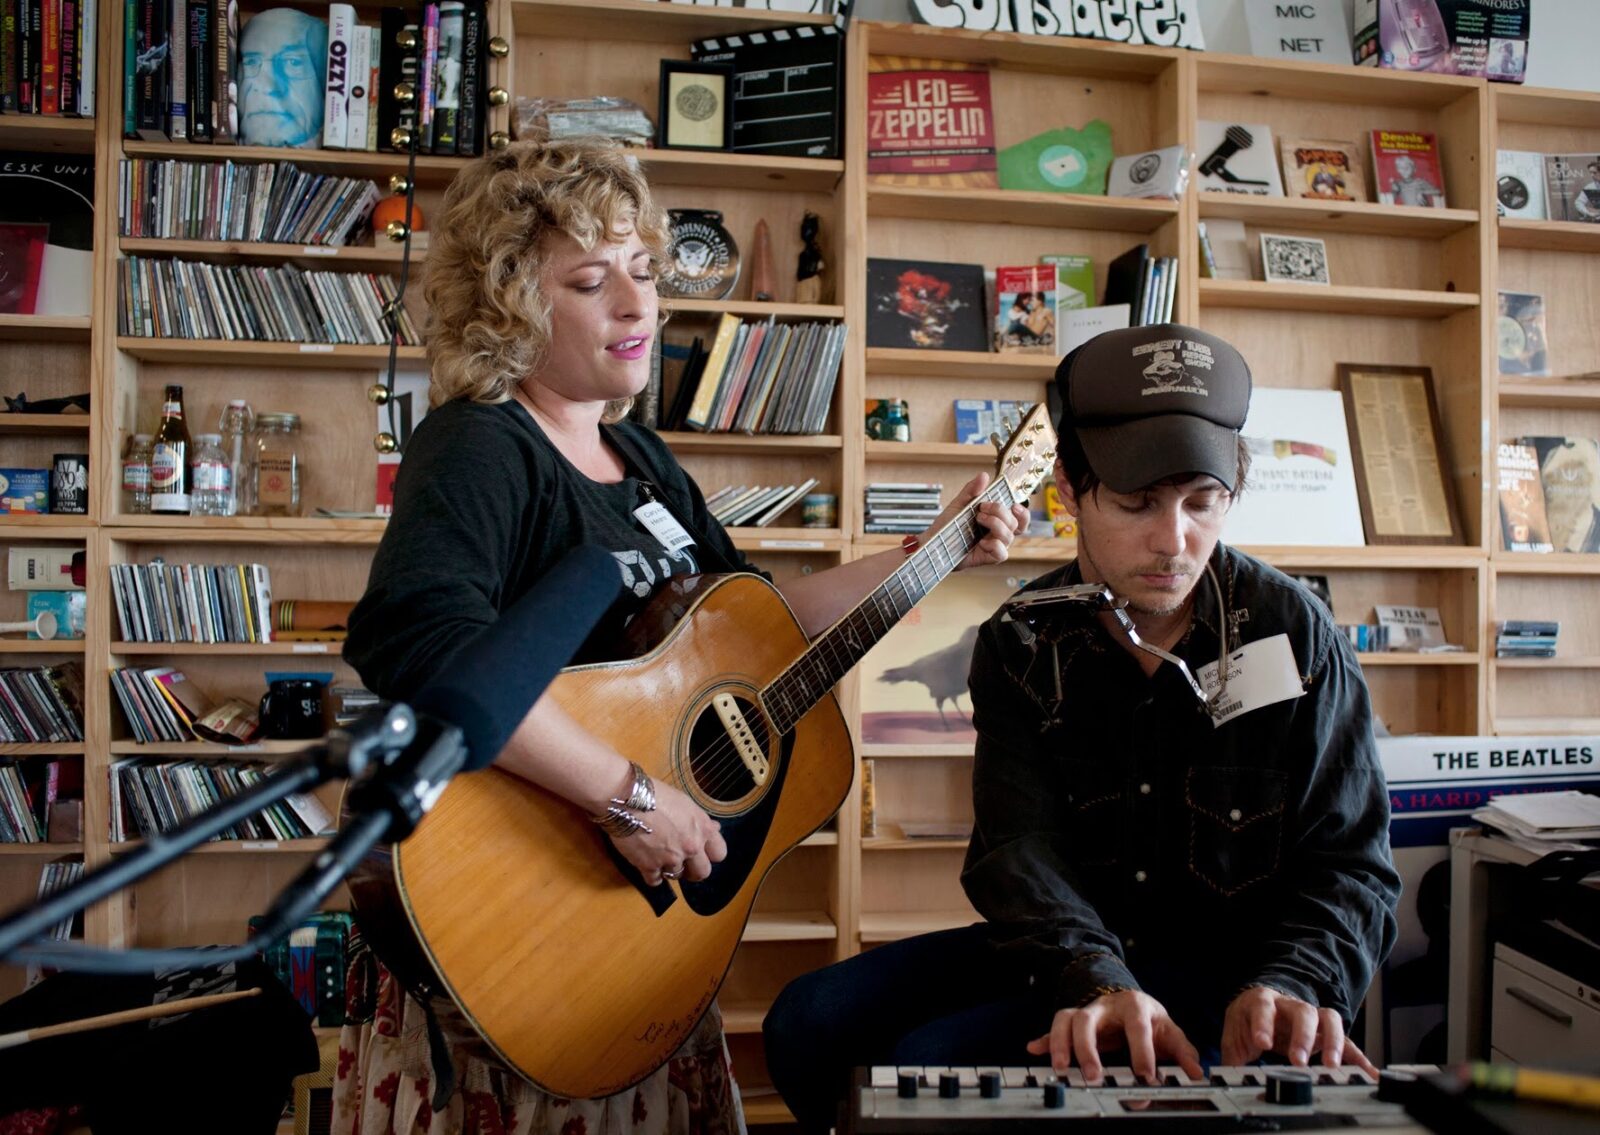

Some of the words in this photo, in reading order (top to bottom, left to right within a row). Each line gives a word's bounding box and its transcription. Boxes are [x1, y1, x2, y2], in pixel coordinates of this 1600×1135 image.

[1276, 5, 1315, 19] MIC
[196, 7, 208, 42] DREAM
[335, 22, 343, 36] AM
[465, 20, 478, 56] SEEING
[1280, 38, 1324, 52] NET
[328, 40, 347, 96] OZZY
[464, 57, 475, 75] THE
[463, 78, 474, 109] LIGHT
[904, 79, 948, 108] LED
[870, 108, 985, 138] ZEPPELIN
[55, 165, 95, 175] UNI
[1185, 341, 1212, 356] TUBB
[1498, 444, 1531, 458] OUL
[1392, 608, 1426, 618] TEXAS
[1433, 751, 1479, 770] THE
[1490, 746, 1593, 768] BEATLES
[1411, 791, 1481, 809] HARD
